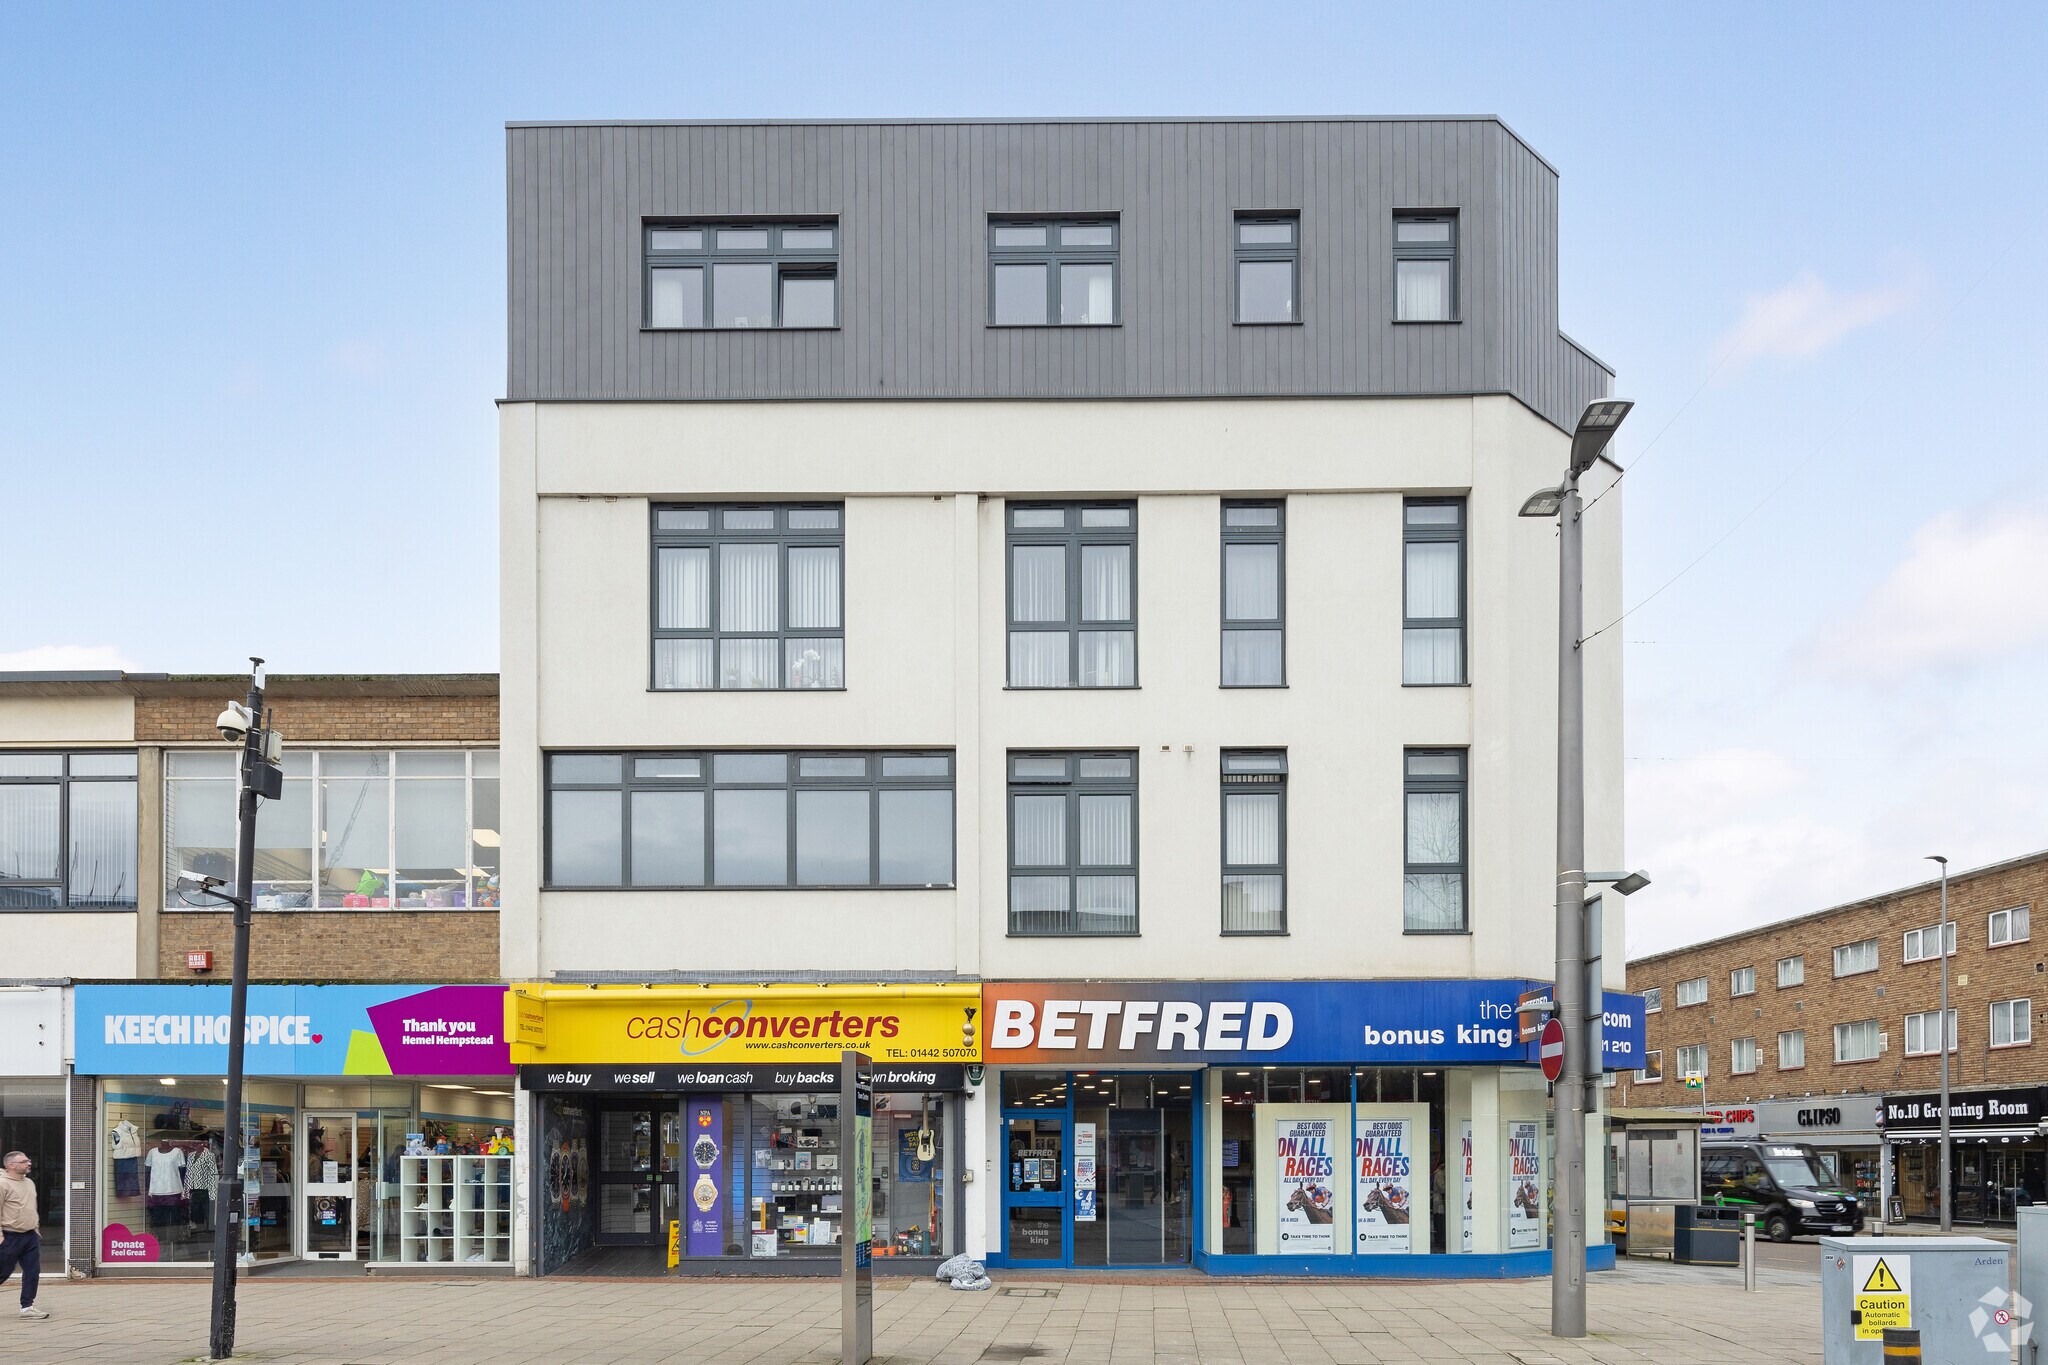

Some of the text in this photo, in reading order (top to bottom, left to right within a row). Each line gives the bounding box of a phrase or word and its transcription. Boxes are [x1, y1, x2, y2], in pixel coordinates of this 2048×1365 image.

[1480, 1000, 1512, 1020] the
[990, 1000, 1294, 1051] BETFRED
[1602, 1011, 1632, 1028] com
[104, 1015, 191, 1045] KEECH
[402, 1018, 476, 1036] Thank you
[402, 1035, 494, 1048] Hemel Hempstead
[1364, 1024, 1513, 1048] bonus king
[745, 1041, 871, 1049] www.cashconverters.co.uk
[1612, 1040, 1632, 1054] 210
[886, 1048, 978, 1058] TEL: 01442 507070
[547, 1071, 592, 1086] we buy
[614, 1071, 656, 1084] we sell
[677, 1071, 754, 1084] we loan cash
[775, 1071, 835, 1086] buy backs
[871, 1073, 887, 1083] wn
[888, 1071, 936, 1085] broking
[1725, 1109, 1755, 1124] CHIPS
[1888, 1104, 1920, 1119] No.10
[1988, 1100, 2028, 1115] Room
[1797, 1107, 1841, 1127] CLIPSO
[1372, 1122, 1387, 1130] BEST
[1365, 1130, 1402, 1138] GUARANTEED
[1018, 1149, 1053, 1157] BETFRED
[1278, 1137, 1327, 1157] ON ALL
[1356, 1137, 1403, 1157] ON ALL
[1509, 1138, 1536, 1157] ON ALL
[1285, 1156, 1333, 1177] RACES
[1361, 1156, 1410, 1177] RACES
[1513, 1156, 1539, 1175] RACES
[1022, 1228, 1049, 1236] bonus
[111, 1240, 145, 1249] Donate
[1030, 1236, 1049, 1245] king
[1974, 1257, 2004, 1266] Arden
[1860, 1299, 1905, 1310] Caution
[1864, 1311, 1901, 1319] Automatic
[1868, 1319, 1897, 1327] bollards
